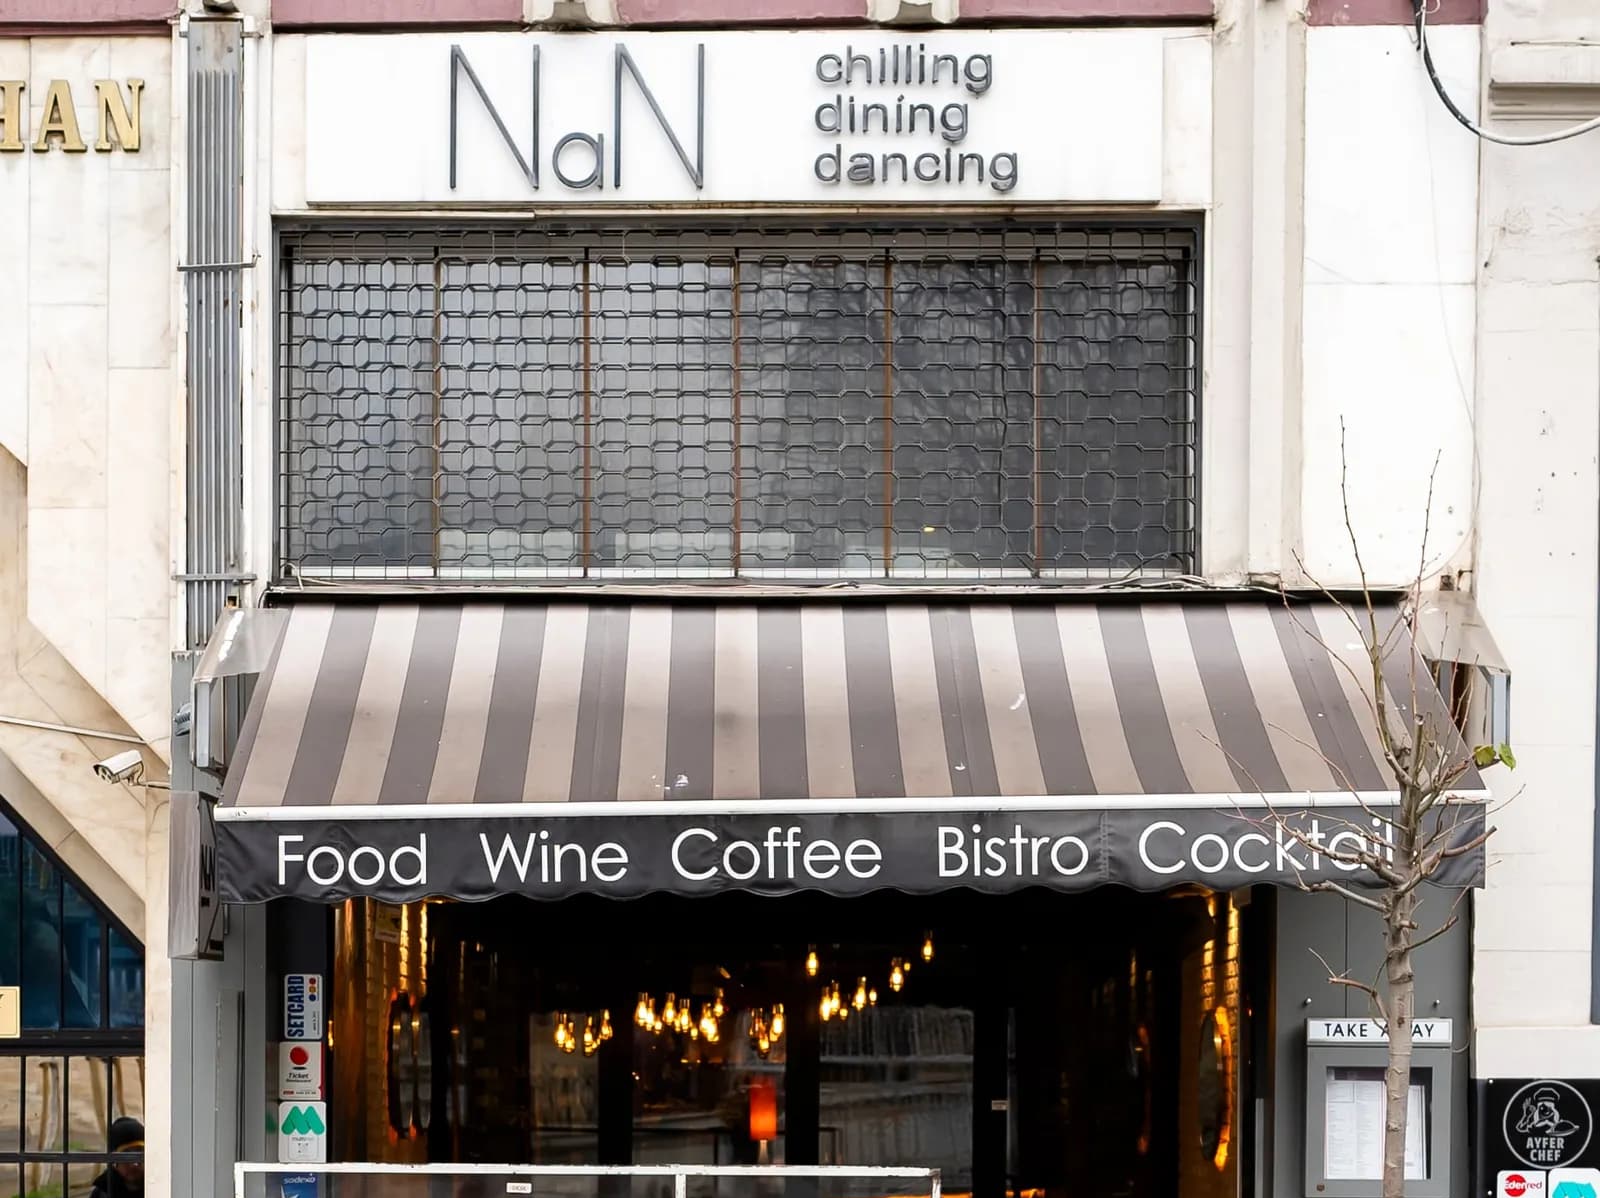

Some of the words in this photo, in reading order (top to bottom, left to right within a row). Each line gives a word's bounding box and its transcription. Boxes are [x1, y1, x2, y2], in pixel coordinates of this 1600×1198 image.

[816, 43, 993, 94] chilling
[450, 44, 705, 190] NaN
[815, 94, 969, 143] dining
[814, 143, 1018, 192] dancing
[278, 833, 427, 886] Food
[480, 830, 629, 883] Wine
[671, 826, 882, 881] Coffee
[938, 823, 1089, 877] Bistro
[1138, 817, 1420, 874] Cocktail
[287, 975, 305, 1038] SETCARD
[1324, 1023, 1368, 1037] TAKE
[1380, 1023, 1434, 1037] AAY
[1526, 1136, 1565, 1149] AYFER
[1529, 1149, 1561, 1162] CHEF
